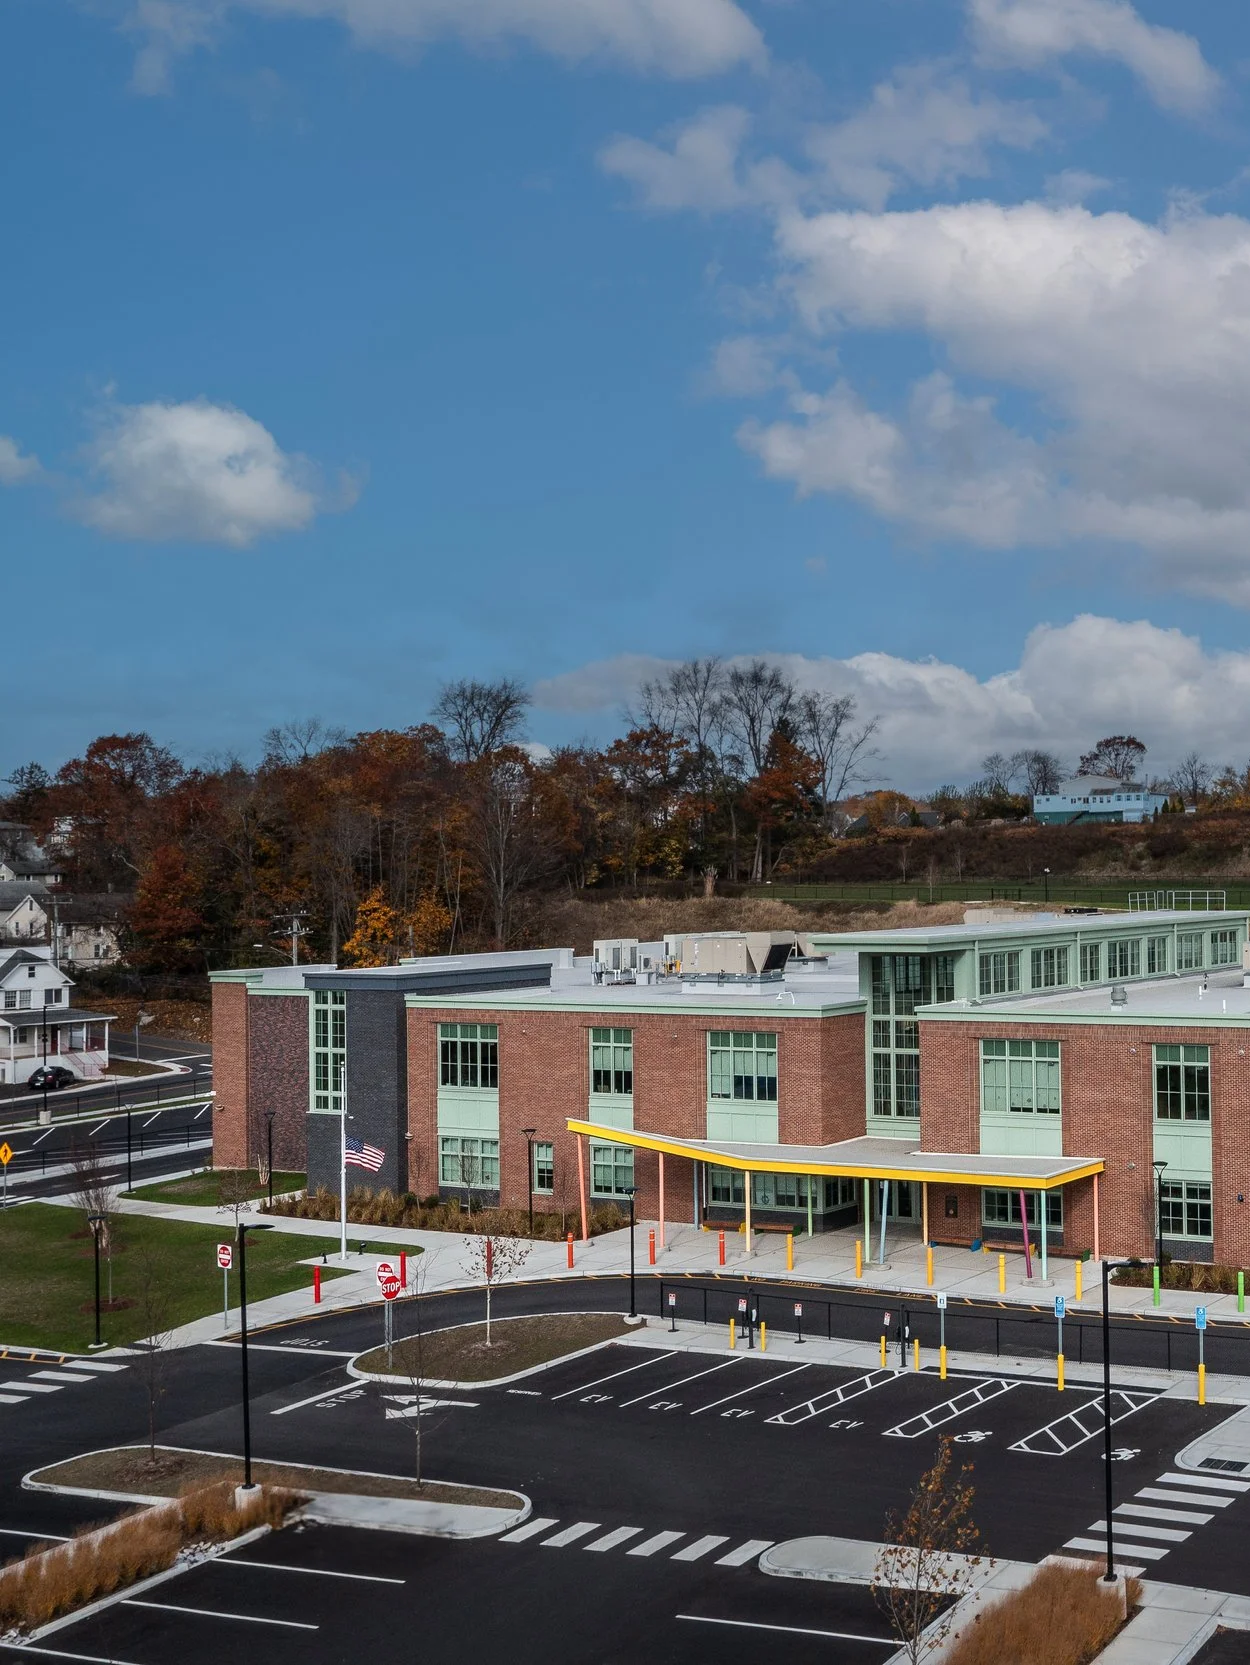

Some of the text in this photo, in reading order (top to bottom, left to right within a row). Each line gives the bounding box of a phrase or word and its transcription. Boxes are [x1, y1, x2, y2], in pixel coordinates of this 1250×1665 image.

[382, 1282, 400, 1293] STOP
[315, 1389, 367, 1408] STOP
[579, 1394, 614, 1403] EV
[648, 1401, 683, 1411] EV
[720, 1408, 756, 1418] EV
[828, 1419, 865, 1430] EV
